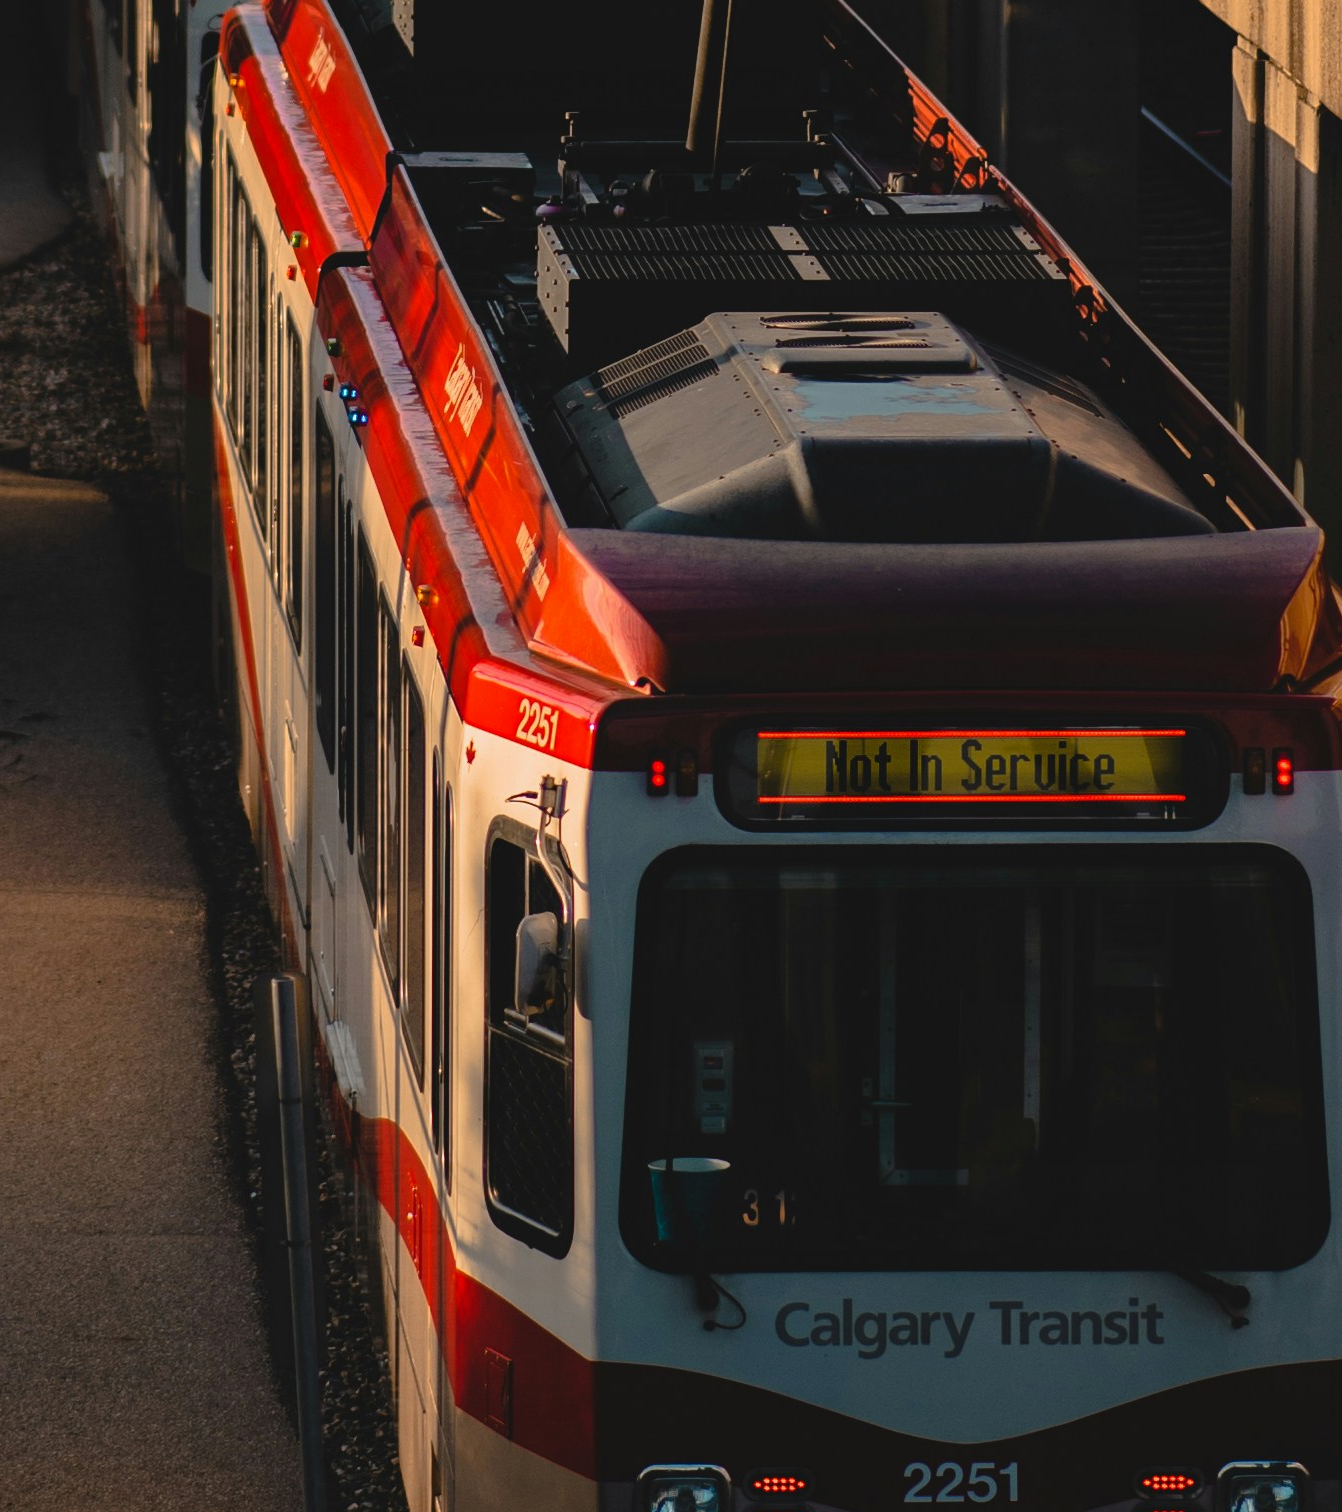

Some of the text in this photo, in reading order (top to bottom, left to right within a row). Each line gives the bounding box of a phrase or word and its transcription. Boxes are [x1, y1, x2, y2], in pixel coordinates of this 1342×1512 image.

[515, 697, 560, 752] 2251
[825, 739, 1116, 793] Not In Service
[774, 1296, 1165, 1360] Calgary Transit
[902, 1461, 1020, 1504] 2251
